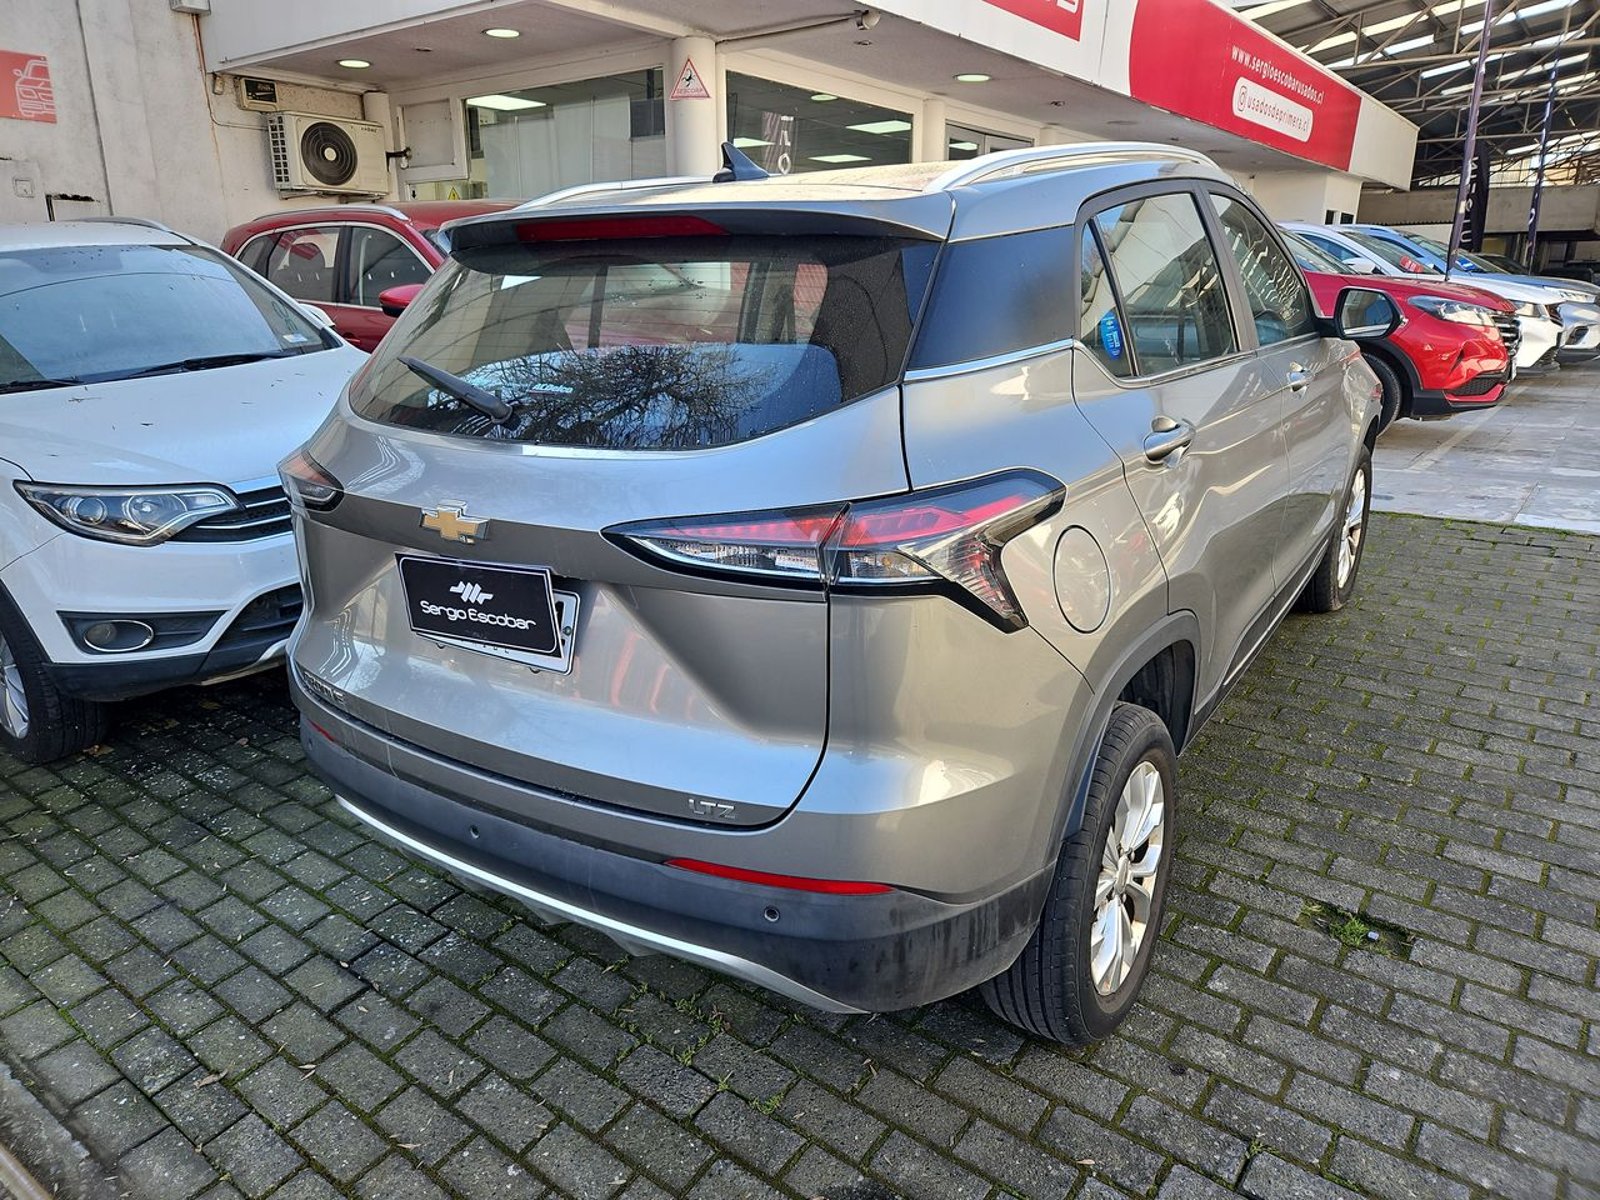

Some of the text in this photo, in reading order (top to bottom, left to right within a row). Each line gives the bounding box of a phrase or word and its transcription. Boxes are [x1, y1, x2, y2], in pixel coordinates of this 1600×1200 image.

[1231, 45, 1325, 105] www.sergioescobarusados.cl
[467, 608, 537, 630] Escobar
[688, 799, 736, 819] LTZ
